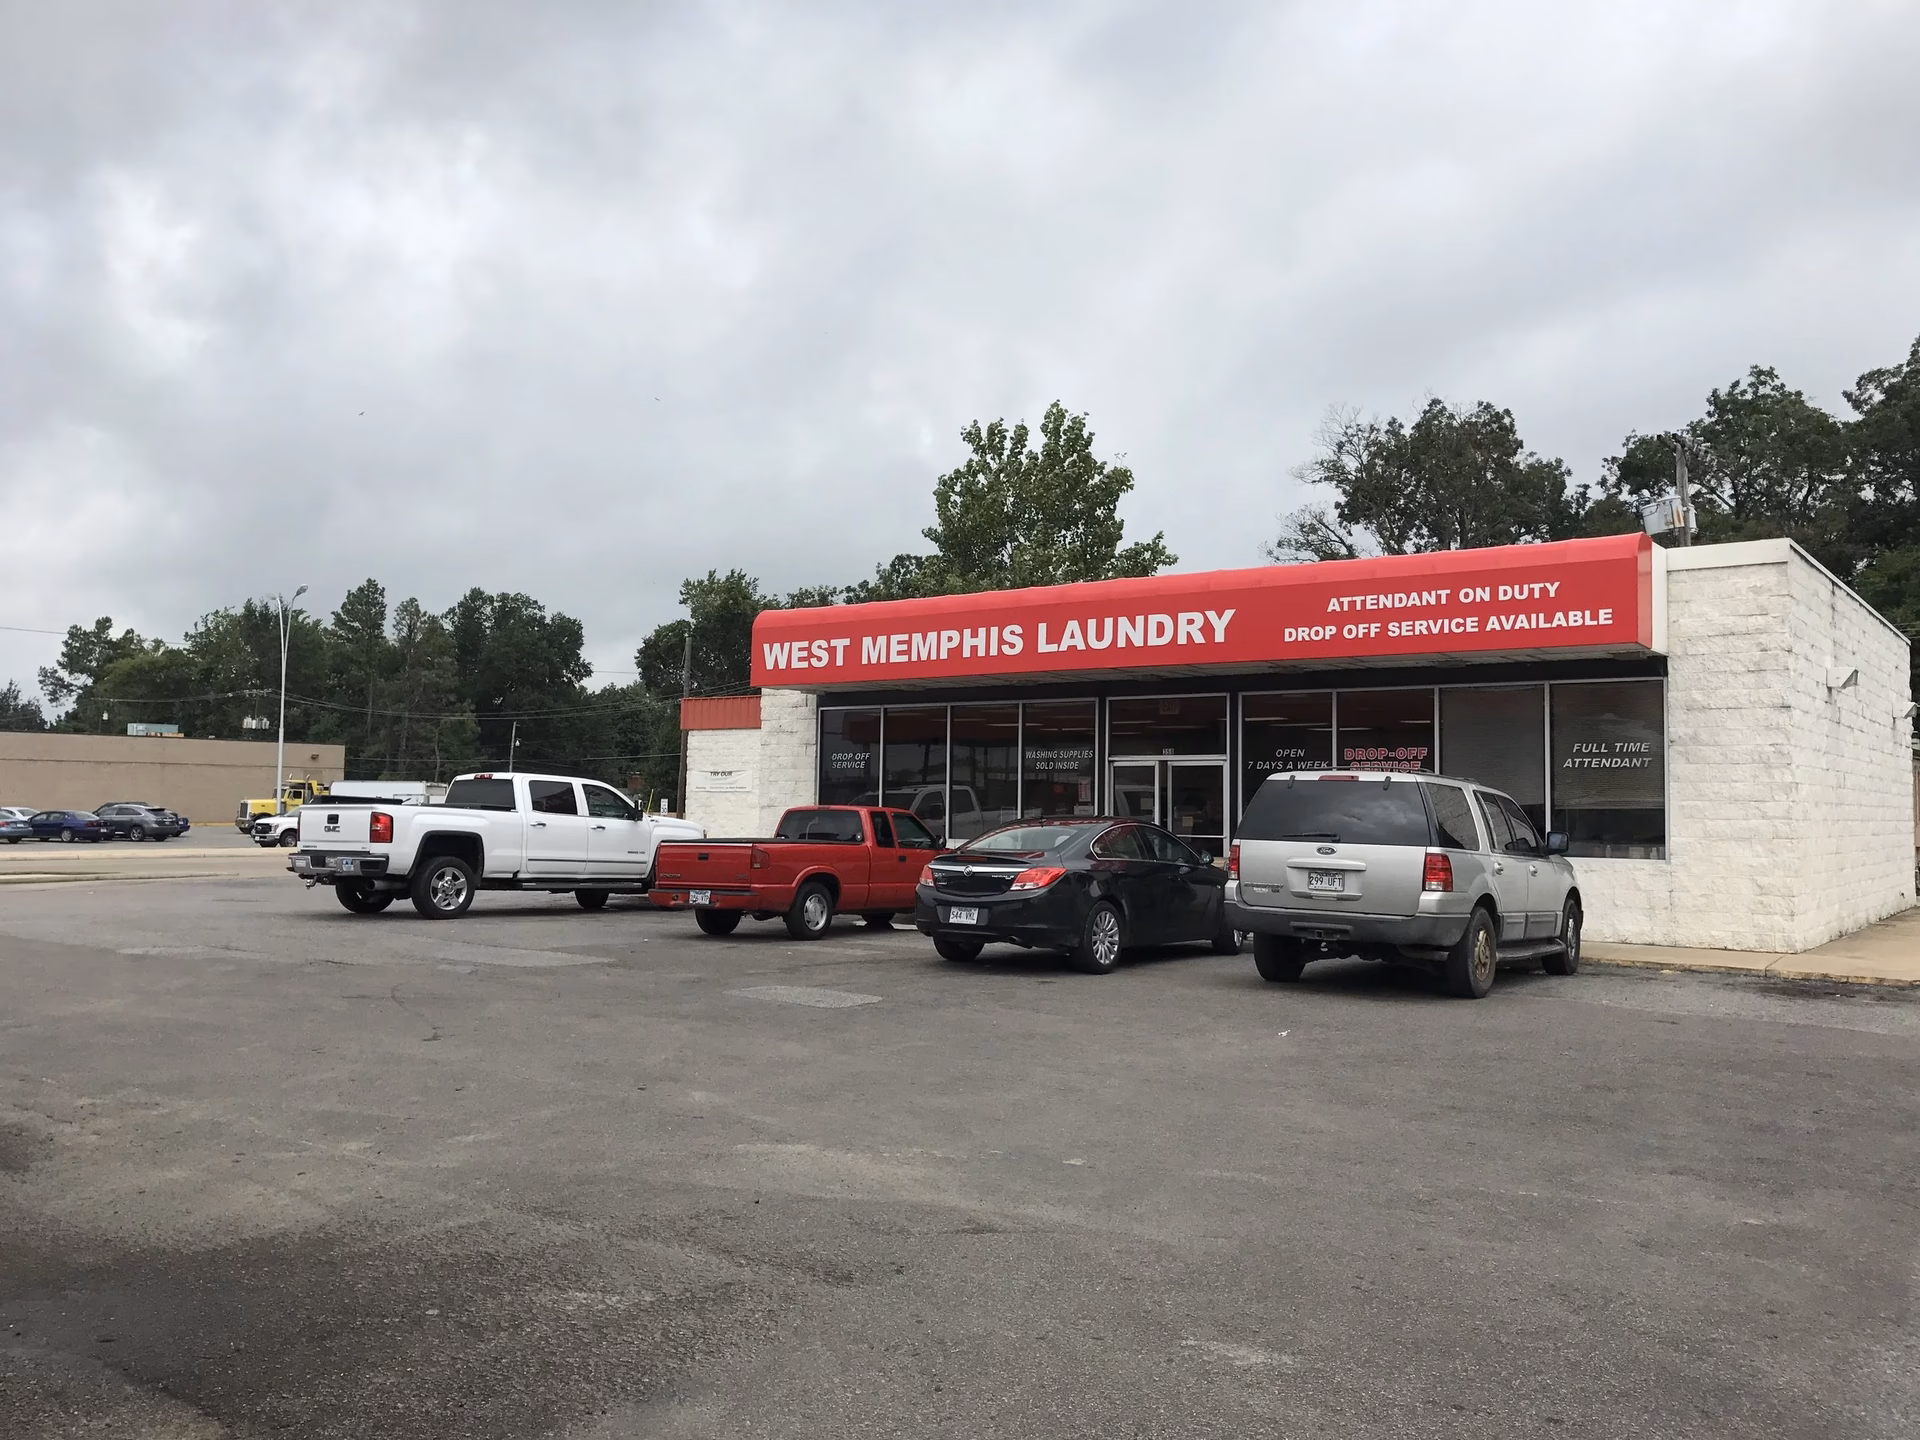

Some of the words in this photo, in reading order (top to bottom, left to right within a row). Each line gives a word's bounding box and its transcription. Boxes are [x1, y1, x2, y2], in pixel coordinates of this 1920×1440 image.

[1326, 589, 1451, 612] ATTENDANT
[1459, 586, 1490, 604] ON
[1498, 581, 1560, 601] DUTY
[1284, 626, 1337, 642] DROP
[1342, 622, 1381, 639] OFF
[1387, 616, 1479, 637] SERVICE
[1485, 608, 1613, 632] AVAILABLE
[763, 637, 851, 670] WEST
[861, 625, 1024, 666] MEMPHIS
[1037, 608, 1236, 654] LAUNDRY
[1275, 749, 1305, 757] OPEN
[1573, 743, 1608, 753] FULL
[1615, 742, 1651, 753] TIME
[1026, 751, 1058, 759] WASHING
[1059, 750, 1094, 759] SUPPLIES
[1344, 747, 1428, 761] DROP-OFF
[832, 761, 866, 769] SERVICE
[1036, 761, 1054, 770] SOLD
[1055, 761, 1079, 770] INSIDE
[1248, 761, 1256, 770] 7
[1257, 761, 1284, 770] DAYS
[1286, 761, 1294, 769] A
[1297, 760, 1329, 769] WEEK
[1563, 757, 1652, 768] ATTENDANT
[1309, 876, 1324, 886] 299
[1328, 877, 1343, 887] UFT
